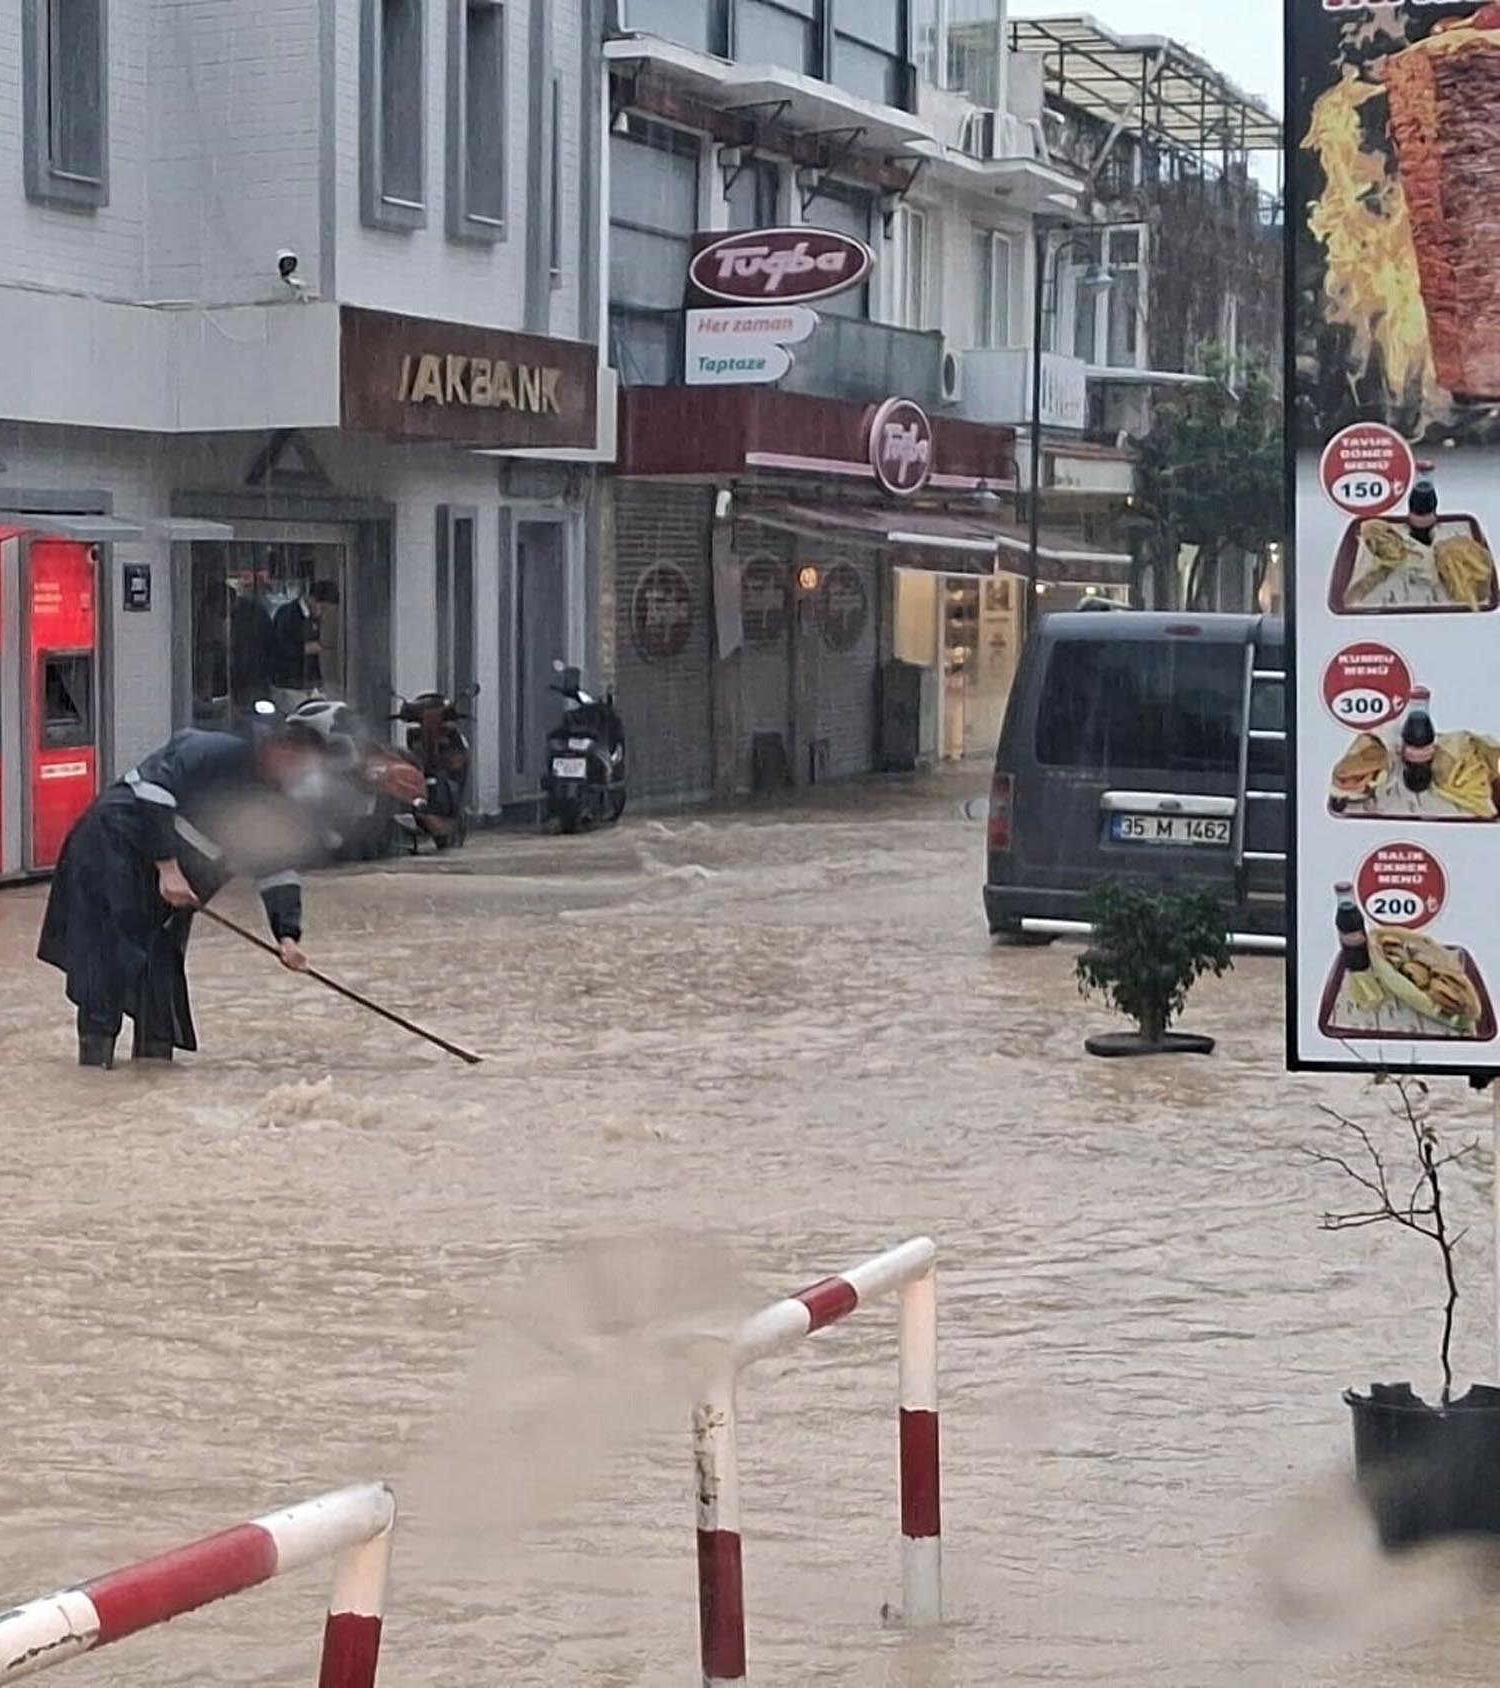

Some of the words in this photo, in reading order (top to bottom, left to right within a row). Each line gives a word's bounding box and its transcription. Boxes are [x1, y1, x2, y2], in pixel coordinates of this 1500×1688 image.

[697, 318, 728, 333] Her
[732, 317, 793, 331] zaman
[699, 357, 766, 374] Taptaze
[410, 353, 561, 414] AKBANK
[1341, 481, 1383, 498] 150
[1341, 698, 1383, 713] 300
[1123, 818, 1145, 836] 35
[1156, 821, 1173, 837] M
[1187, 821, 1228, 841] 1462
[1373, 898, 1416, 915] 200
